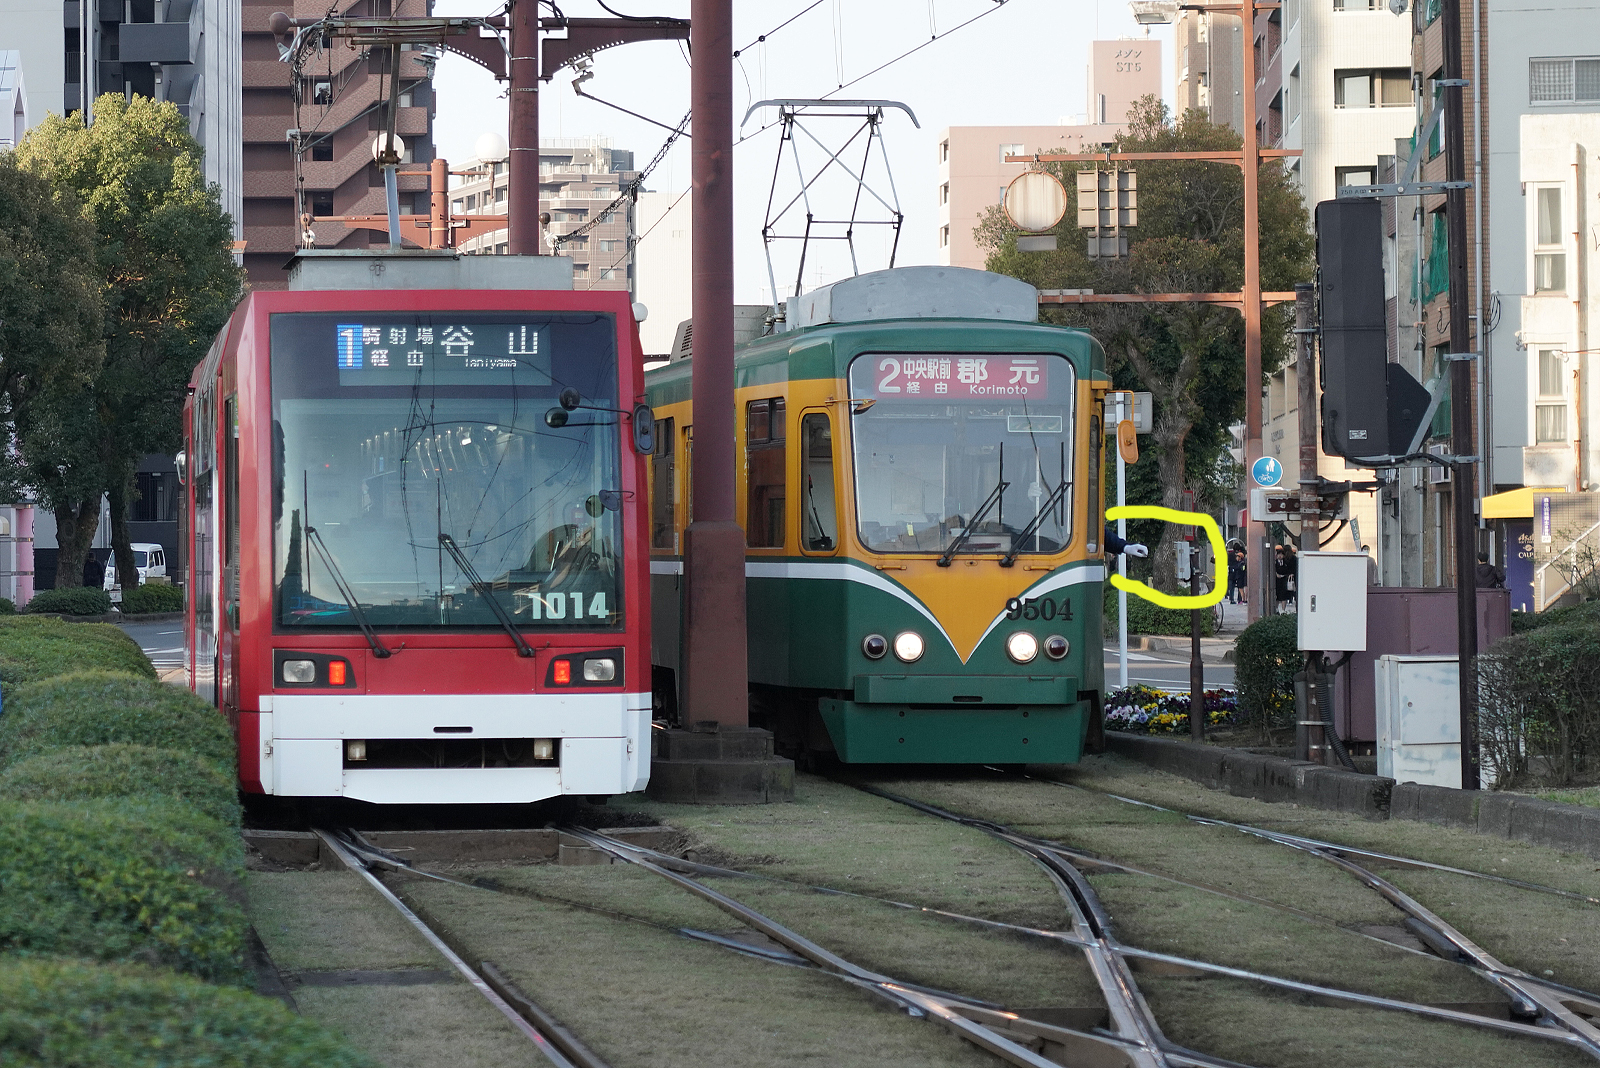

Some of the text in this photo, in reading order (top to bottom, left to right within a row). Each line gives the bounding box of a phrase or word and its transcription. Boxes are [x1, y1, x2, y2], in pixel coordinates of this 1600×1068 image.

[340, 328, 353, 367] 1
[440, 325, 538, 357] 谷山
[878, 357, 901, 393] 2
[903, 357, 952, 380] 中央駅前
[956, 358, 1040, 384] 郡元
[906, 381, 948, 394] 経由
[969, 384, 1028, 395] Korimoto
[529, 592, 610, 620] 1014
[1005, 597, 1074, 621] 9504
